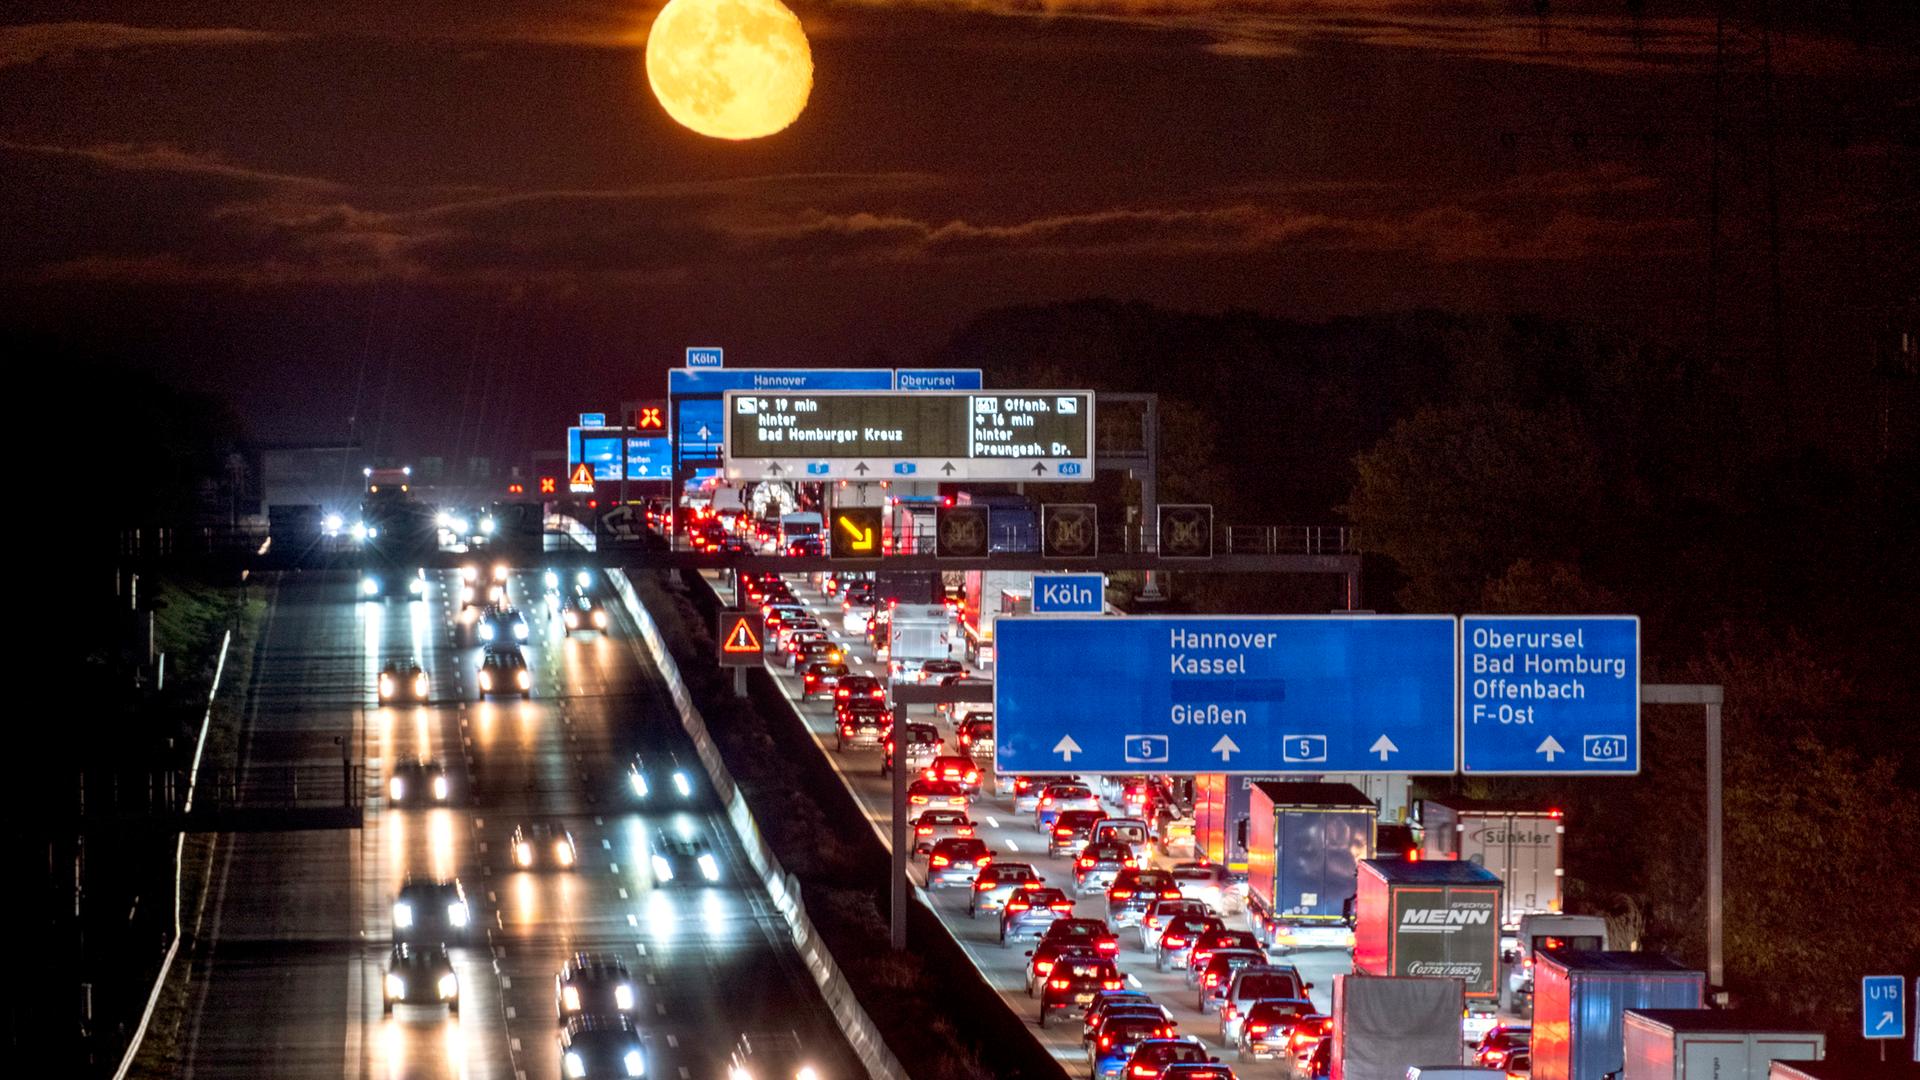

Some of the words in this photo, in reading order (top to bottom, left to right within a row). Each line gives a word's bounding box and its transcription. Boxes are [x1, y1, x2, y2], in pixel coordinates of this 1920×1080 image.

[692, 352, 718, 364] Köln
[754, 374, 806, 386] Hannover
[901, 374, 955, 386] Oberursel
[775, 399, 788, 412] 19
[794, 398, 817, 412] min
[1004, 398, 1050, 412] Offenb.
[758, 413, 796, 426] hinter
[992, 413, 1004, 426] 16
[1011, 413, 1034, 426] min
[758, 428, 783, 441] Bad
[789, 428, 858, 443] Homburger
[864, 428, 903, 441] Kreuz
[975, 428, 1013, 441] hinter
[1052, 442, 1071, 456] Dr.
[1062, 463, 1078, 474] 661
[1043, 583, 1092, 604] Köln
[1170, 628, 1277, 649] Hannover
[1473, 628, 1584, 648] Oberursel
[1170, 654, 1246, 674] Kassel
[1473, 654, 1514, 673] Bad
[1525, 654, 1626, 679] Homburg
[1473, 679, 1585, 699] Offenbach
[1171, 704, 1247, 724] Gießen
[1473, 704, 1535, 724] F-Ost
[1141, 740, 1152, 757] 5
[1299, 740, 1310, 757] 5
[1592, 740, 1619, 757] 661
[1486, 831, 1551, 844] Sünkler
[1402, 909, 1490, 924] MENN
